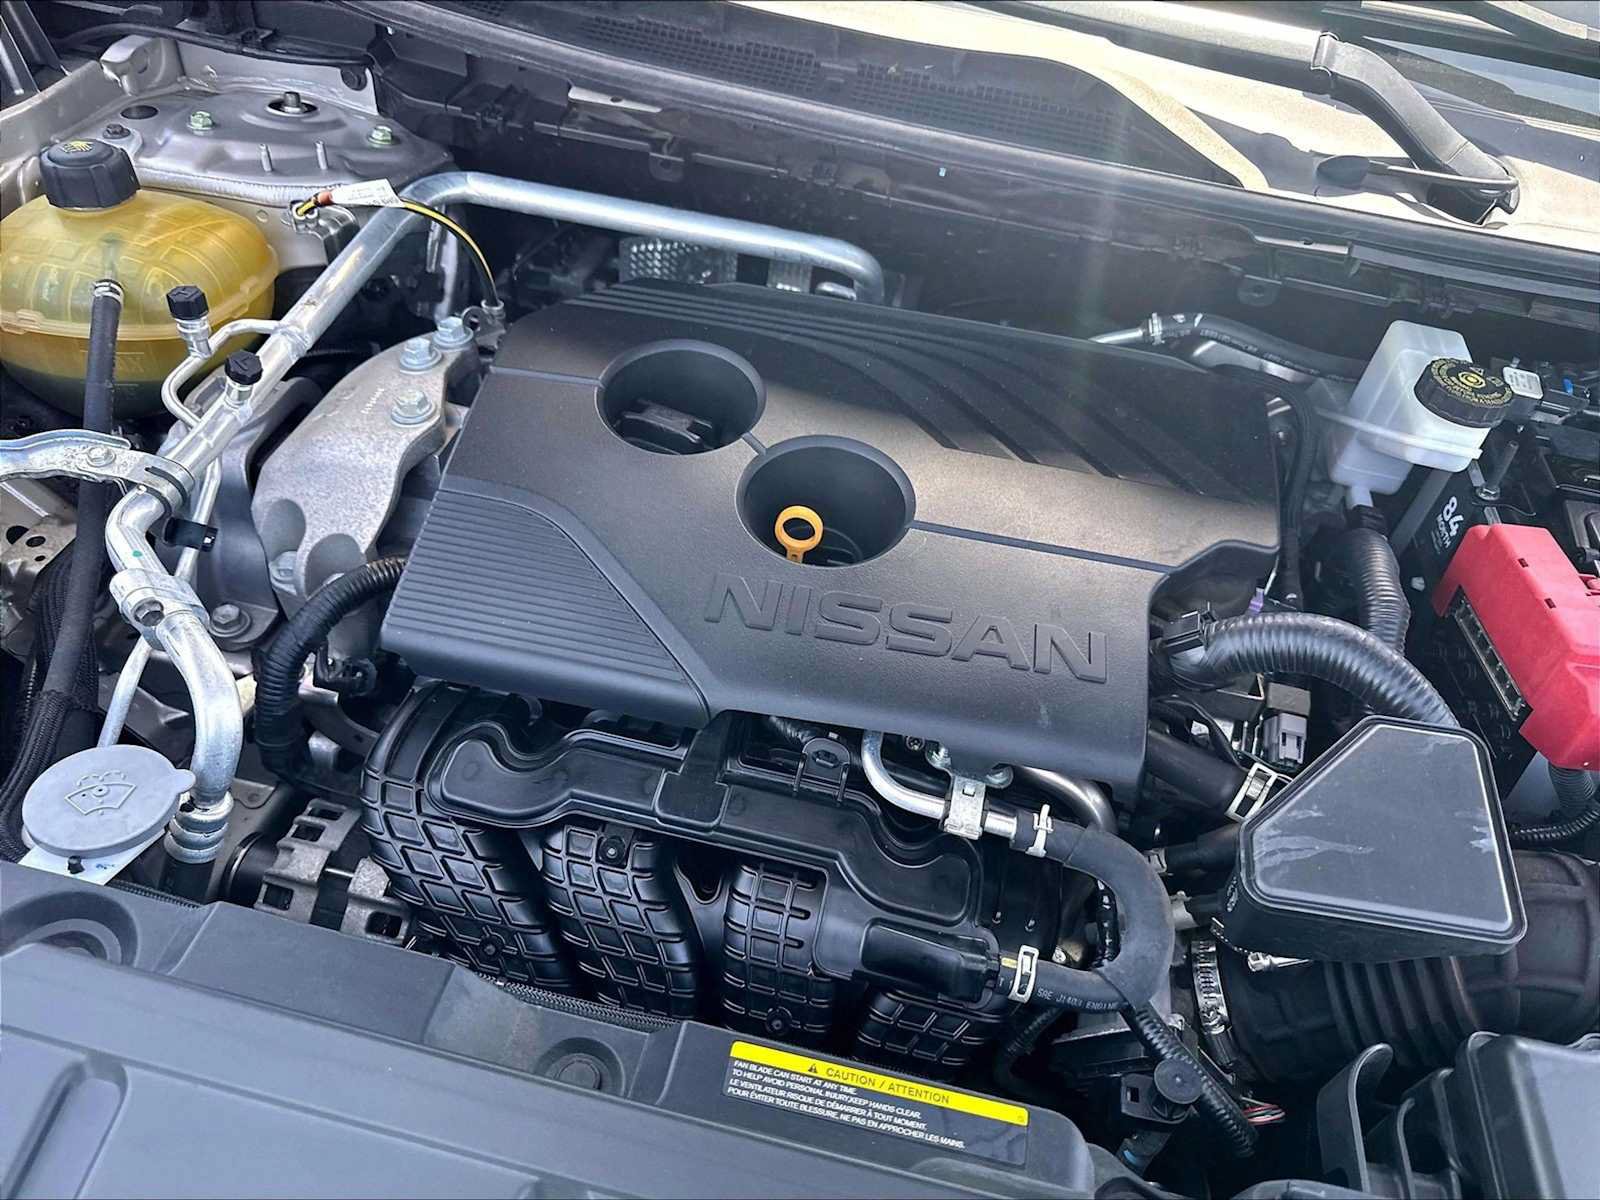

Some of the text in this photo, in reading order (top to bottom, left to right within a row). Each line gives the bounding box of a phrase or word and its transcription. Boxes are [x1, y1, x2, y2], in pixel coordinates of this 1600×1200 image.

[1442, 496, 1464, 537] 84
[704, 573, 1107, 684] NISSAN
[1037, 988, 1053, 1000] SAE
[732, 1068, 743, 1076] TO
[743, 1071, 762, 1080] HELP
[762, 1075, 785, 1086] AVOID
[785, 1081, 824, 1095] PERSONAL
[850, 1096, 870, 1106] KEEP
[869, 1100, 895, 1112] HANDS
[895, 1107, 922, 1118] CLEAR.
[734, 1060, 858, 1094] FAN BLADE CAN START AT ANY TIME.
[826, 1067, 876, 1086] CAUTION
[888, 1082, 950, 1103] ATTENTION
[727, 1086, 749, 1097] POUR
[750, 1089, 776, 1103] ÉVITER
[775, 1098, 800, 1109] TOUTE
[839, 1113, 852, 1121] NE
[851, 1115, 867, 1125] PAS
[866, 1119, 878, 1127] EN
[878, 1122, 925, 1138] APPROCHER
[925, 1133, 940, 1142] LES
[940, 1137, 965, 1148] MAINS.
[729, 1077, 740, 1085] LE
[739, 1080, 787, 1096] VENTILATEUR
[786, 1091, 815, 1103] RISQUE
[814, 1097, 826, 1106] DE
[825, 1098, 867, 1115] DÉMARRER
[873, 1111, 893, 1122] TOUT
[893, 1116, 928, 1130] MOMENT.
